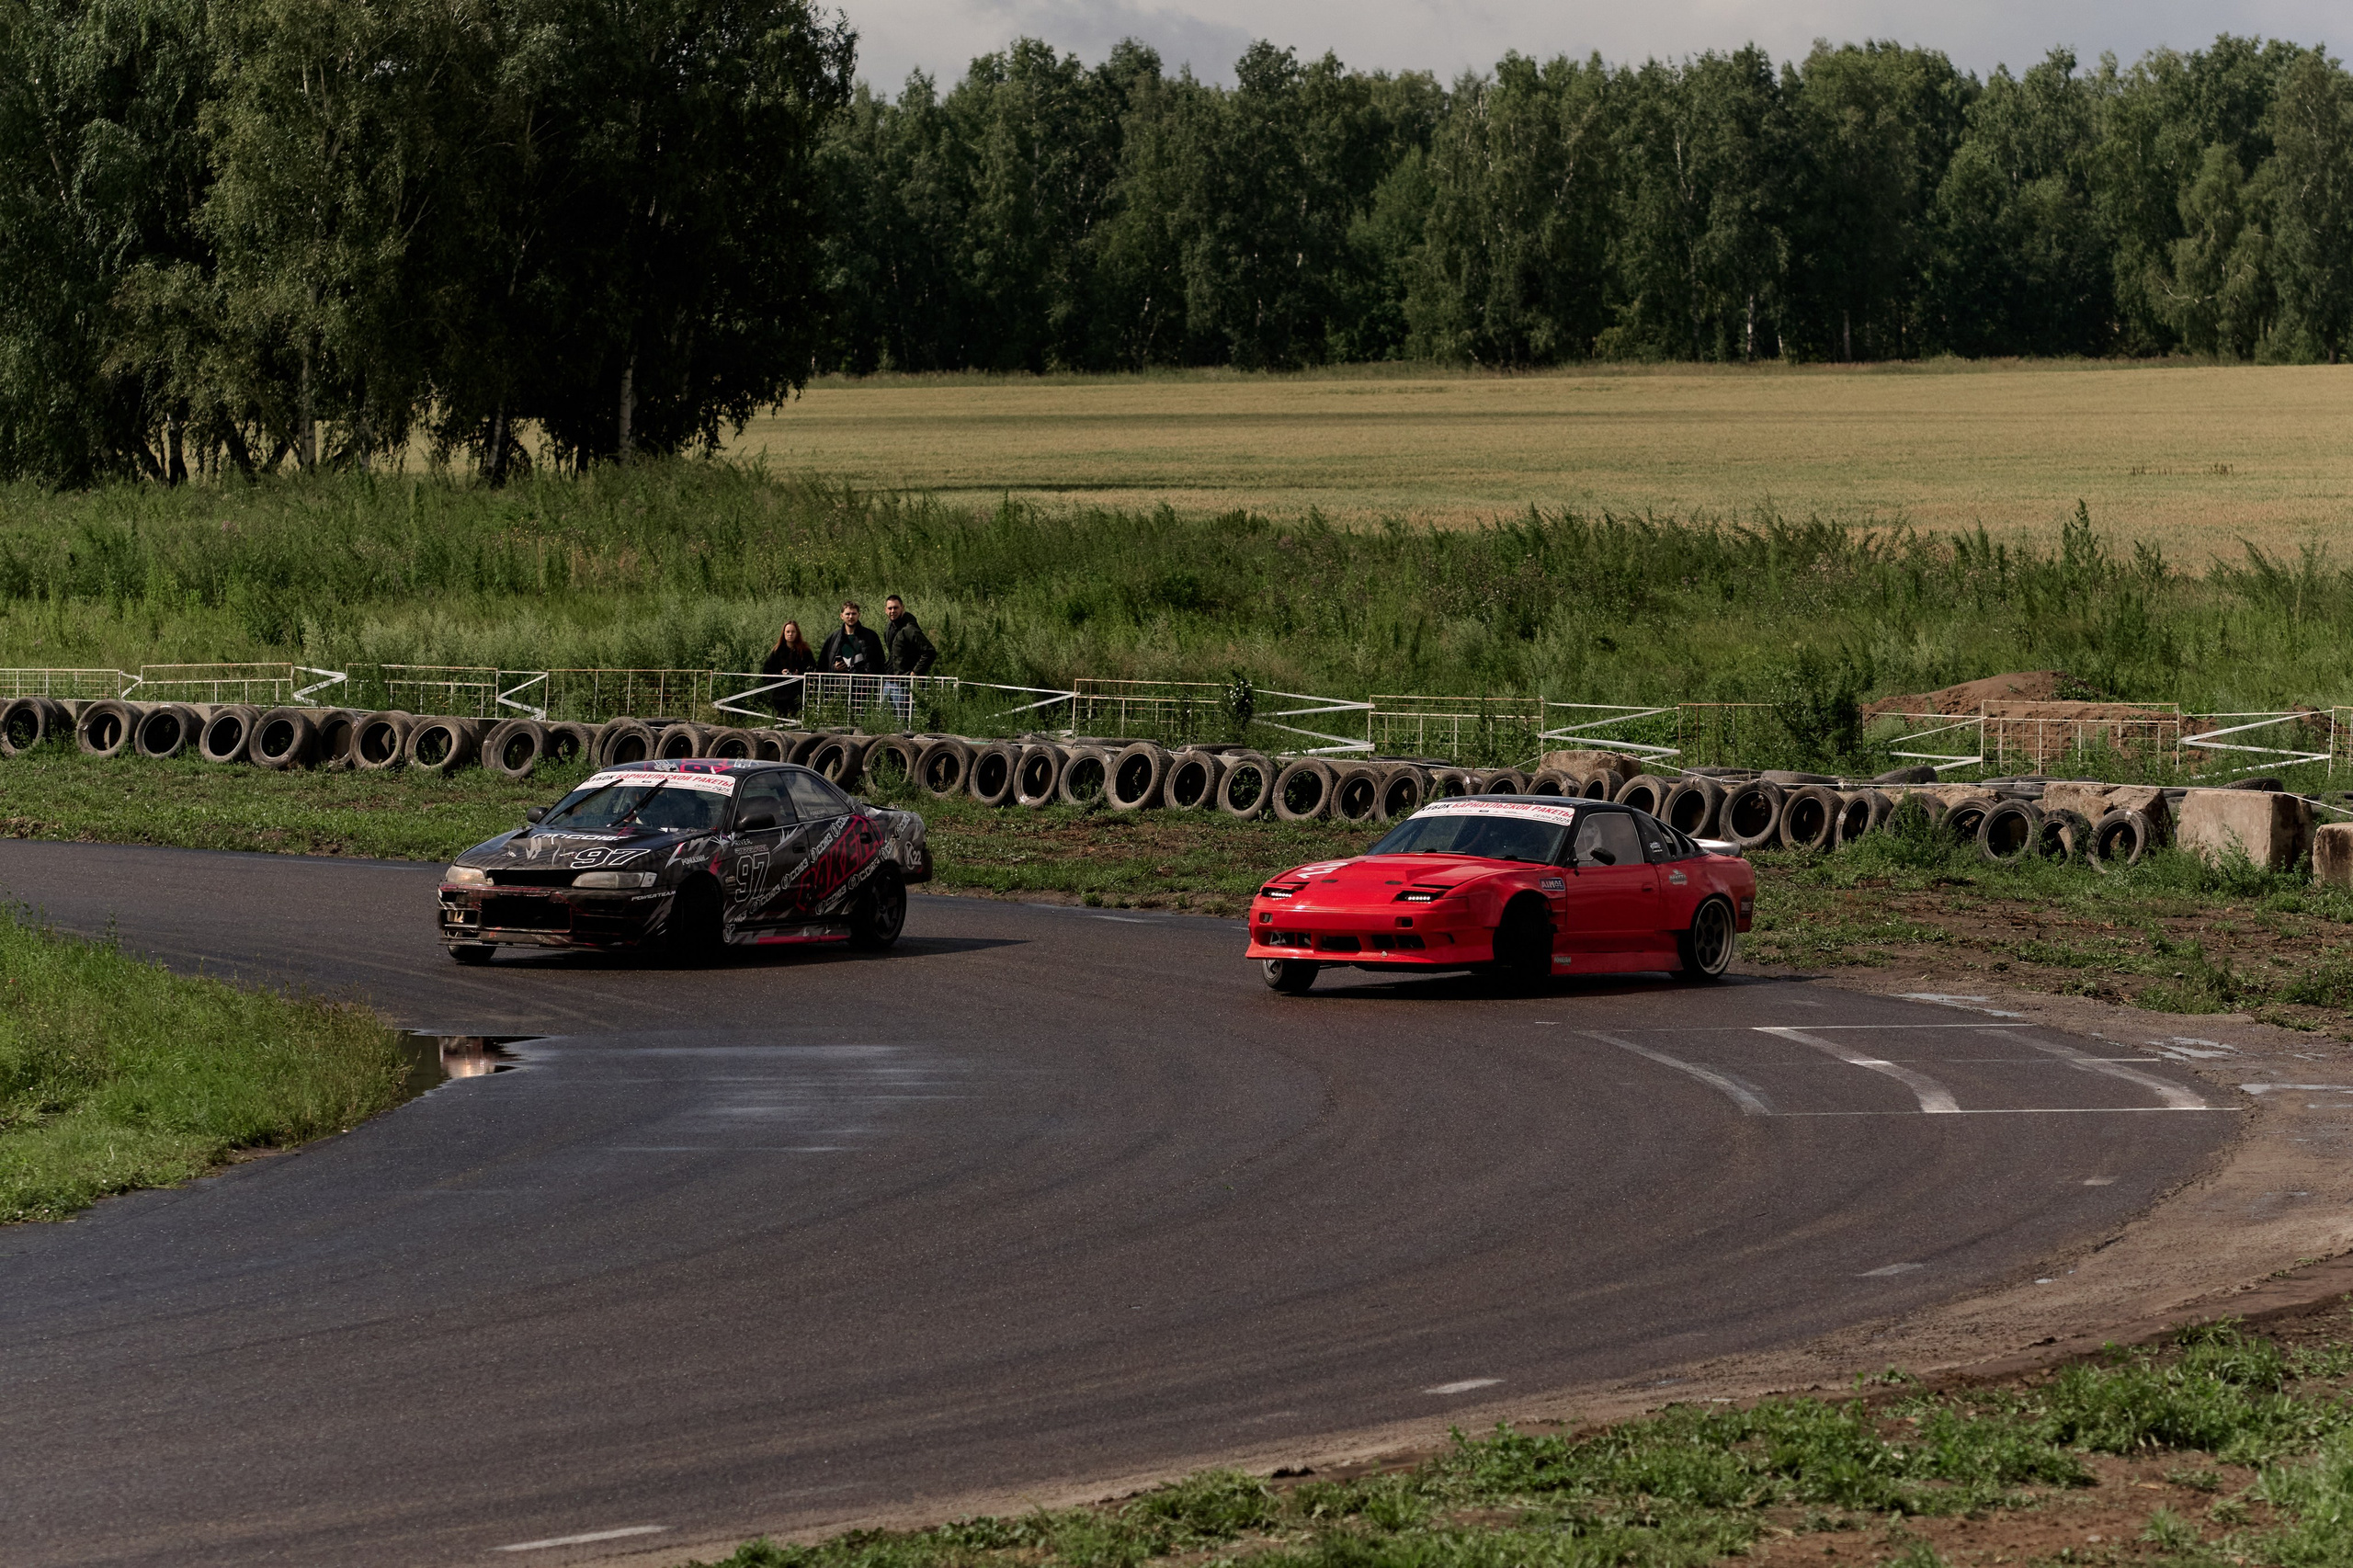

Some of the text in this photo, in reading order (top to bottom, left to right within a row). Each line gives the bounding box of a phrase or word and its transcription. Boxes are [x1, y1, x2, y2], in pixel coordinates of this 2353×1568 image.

[616, 773, 692, 781] БАРНАУЛЬСКОЙ
[693, 776, 733, 788] РАКЕТЫ
[1452, 801, 1531, 811] БАРНАУЛЬСКОЙ
[1531, 804, 1574, 818] РАКЕТЫ
[1552, 815, 1572, 824] 2025
[570, 846, 652, 869] 97
[734, 852, 770, 903] 97
[631, 890, 676, 902] POWERTEAM
